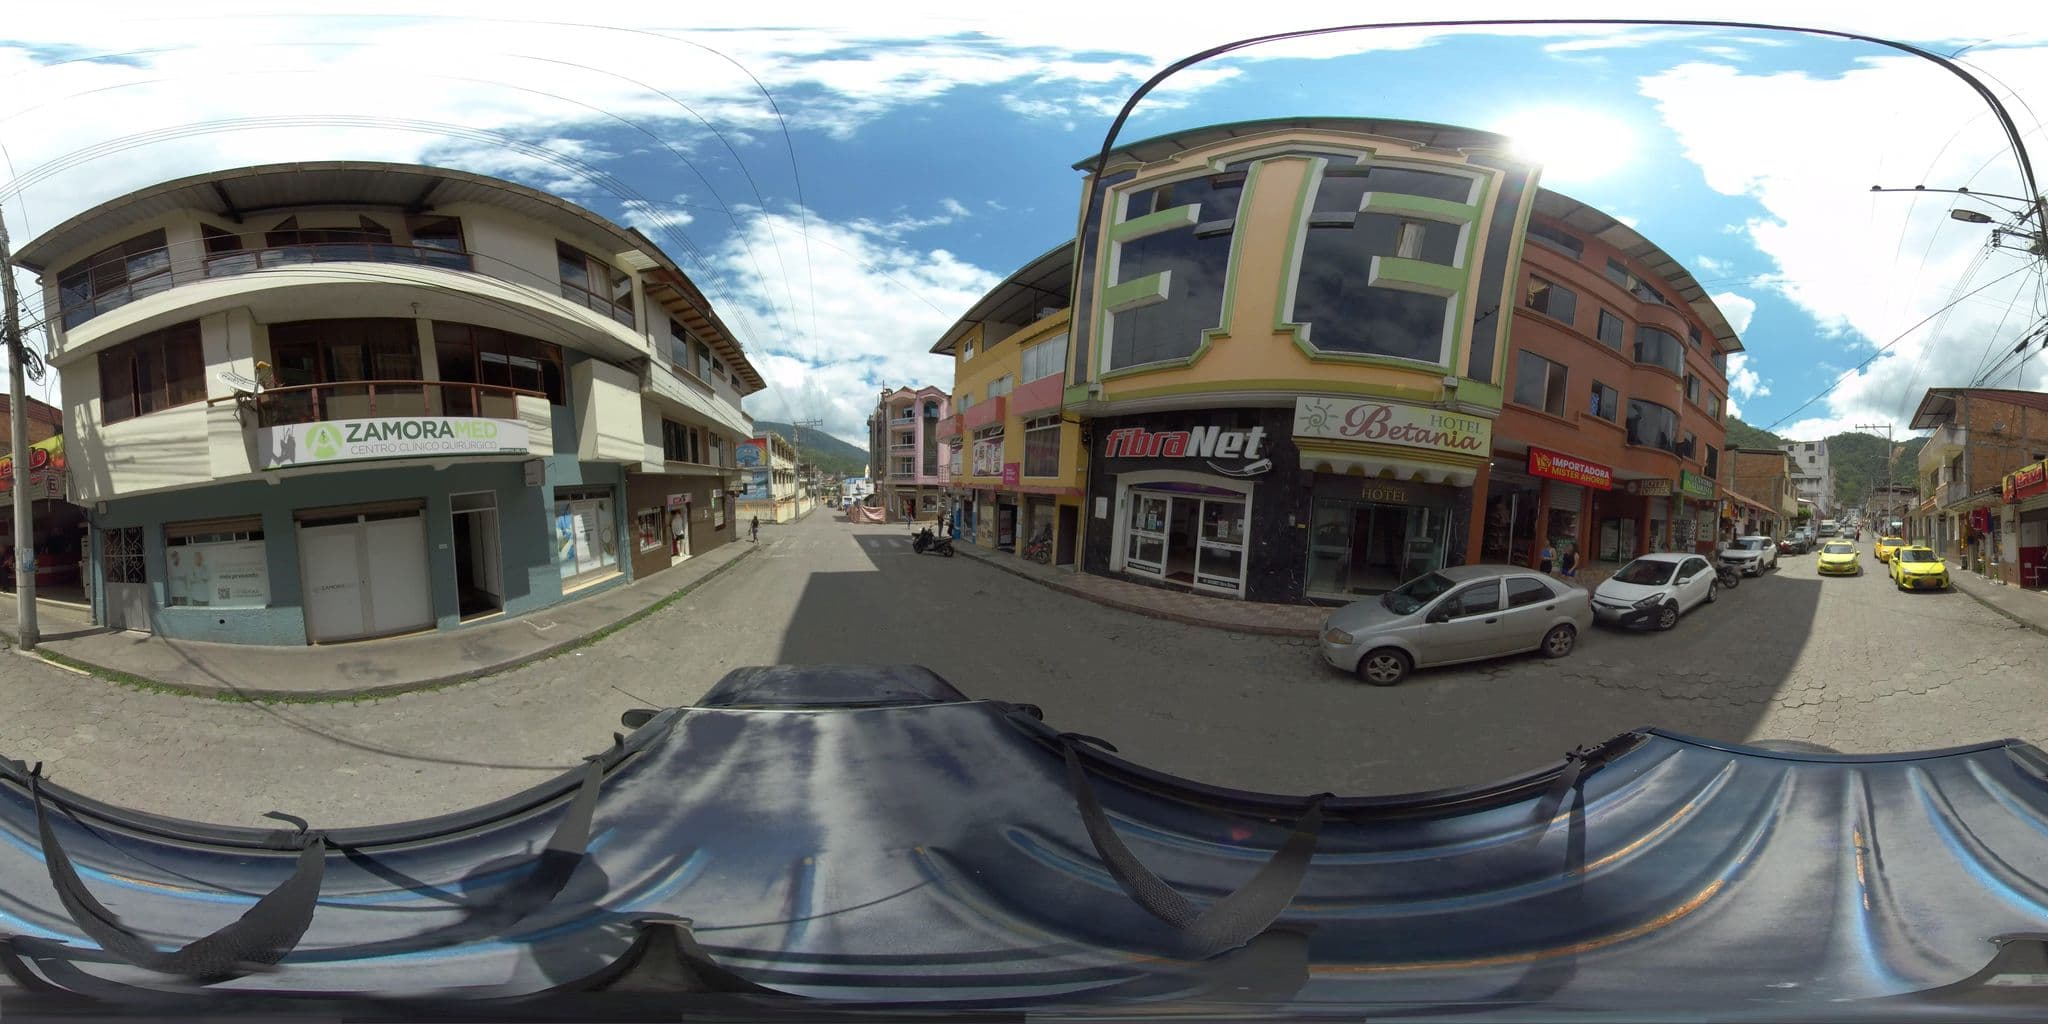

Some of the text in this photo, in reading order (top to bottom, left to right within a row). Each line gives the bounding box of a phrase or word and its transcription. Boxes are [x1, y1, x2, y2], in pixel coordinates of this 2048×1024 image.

[1339, 403, 1482, 451] Betania
[1430, 414, 1482, 434] HOTEL
[350, 443, 396, 455] CENTRO
[1104, 425, 1268, 460] fibraNet
[1551, 466, 1579, 480] MISTER
[1552, 456, 1610, 479] IMPORTADORA
[1362, 487, 1408, 502] HOTEL
